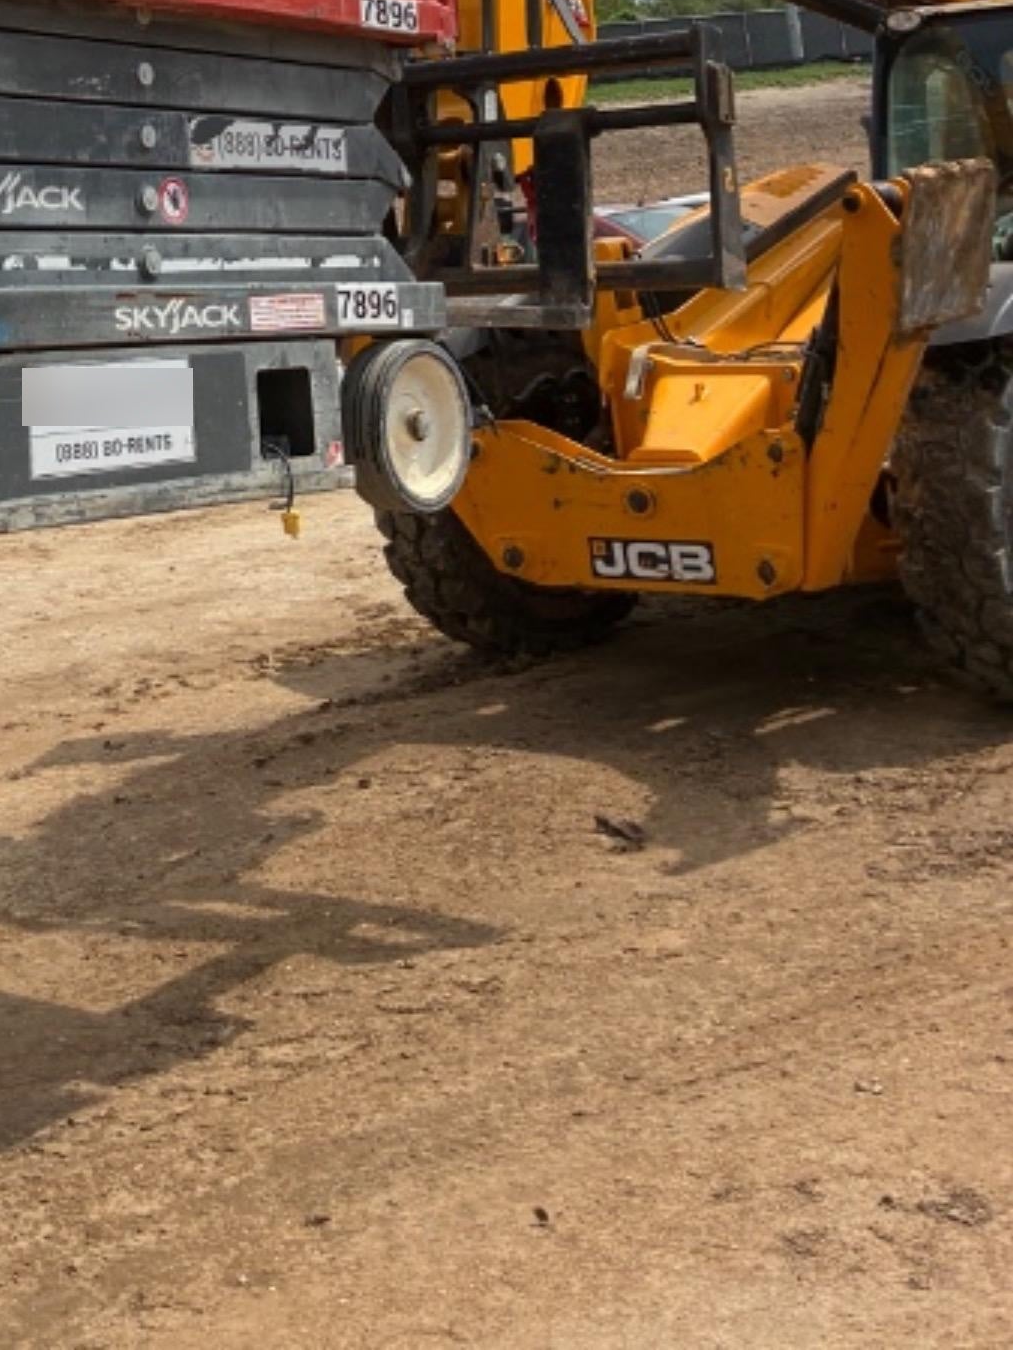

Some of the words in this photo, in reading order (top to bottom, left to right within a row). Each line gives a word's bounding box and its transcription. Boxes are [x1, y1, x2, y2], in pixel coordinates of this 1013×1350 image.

[115, 297, 240, 334] SKYJACK
[338, 289, 397, 320] 7896
[593, 541, 715, 581] JCB
